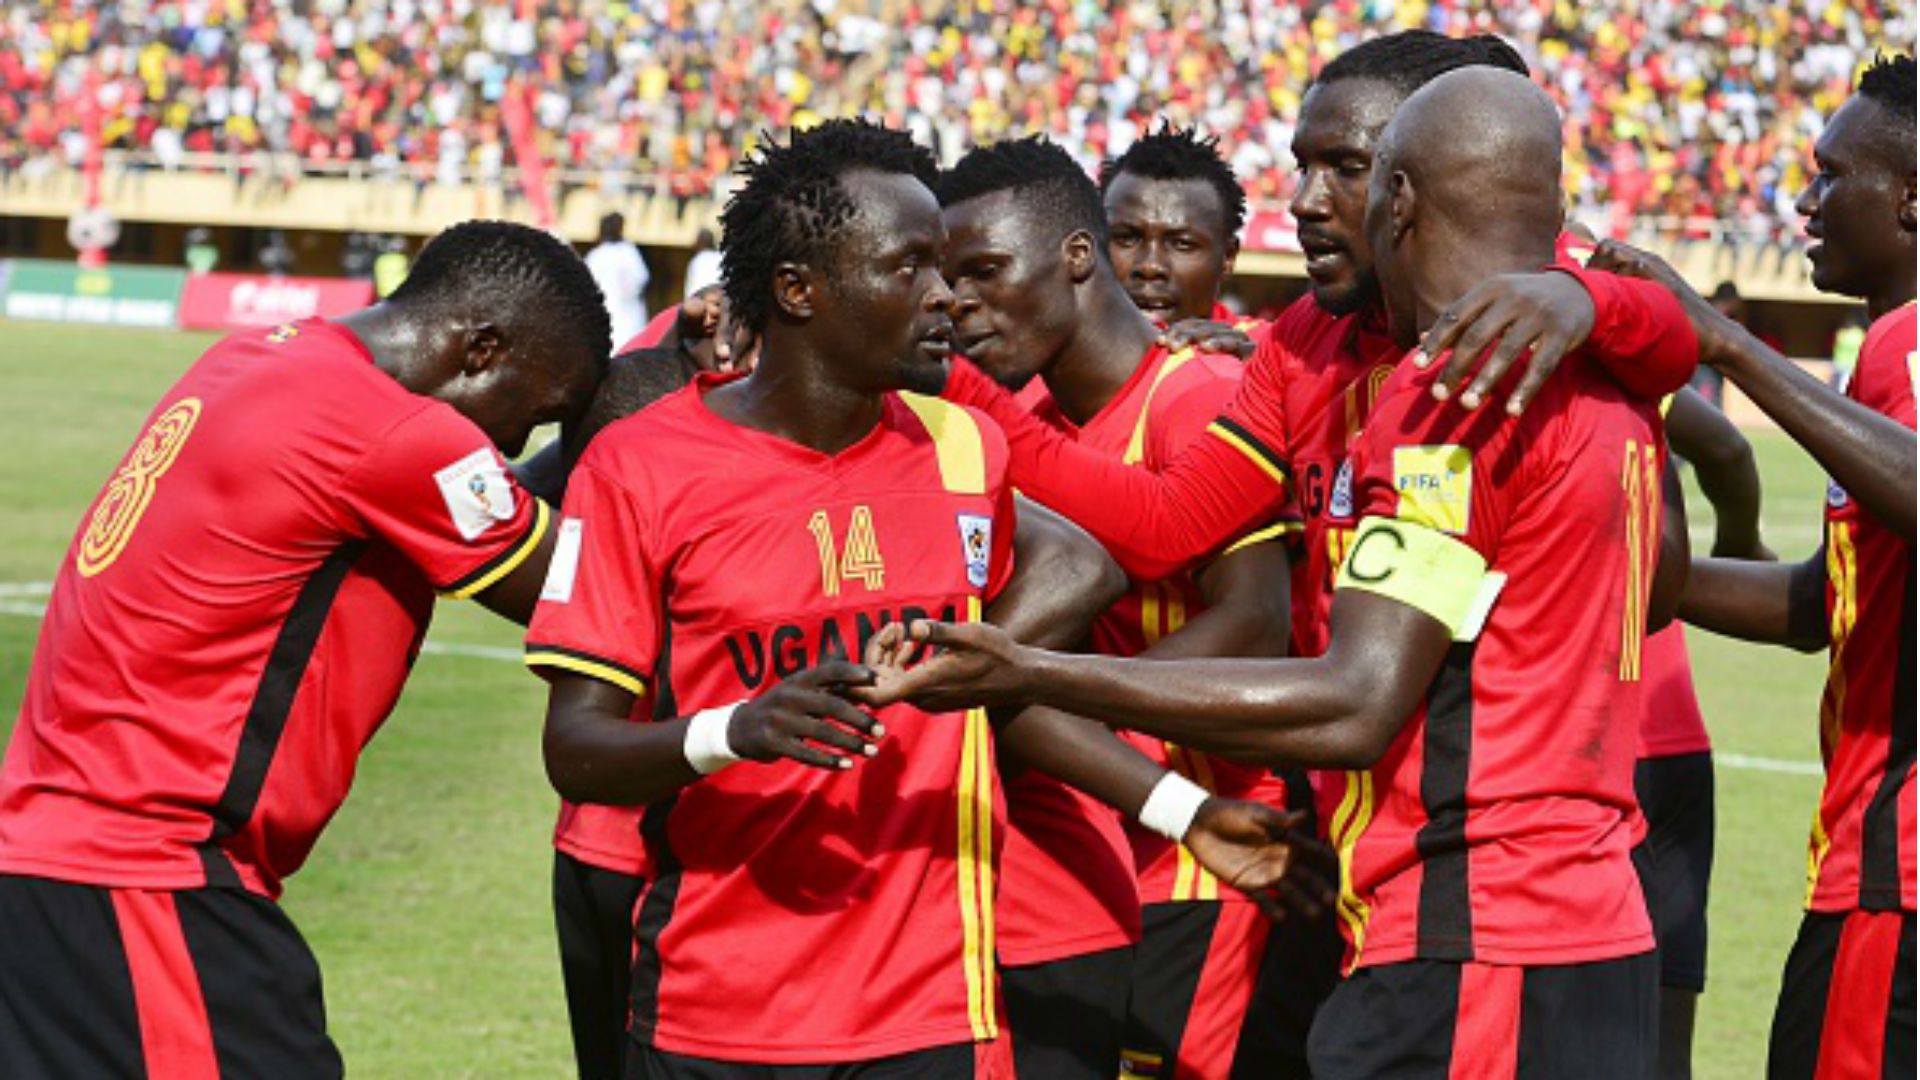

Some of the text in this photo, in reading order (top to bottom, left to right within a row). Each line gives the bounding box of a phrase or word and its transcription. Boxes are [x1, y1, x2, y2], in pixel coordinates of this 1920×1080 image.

[77, 397, 202, 577] 8
[808, 506, 884, 597] 14
[1347, 525, 1406, 582] C
